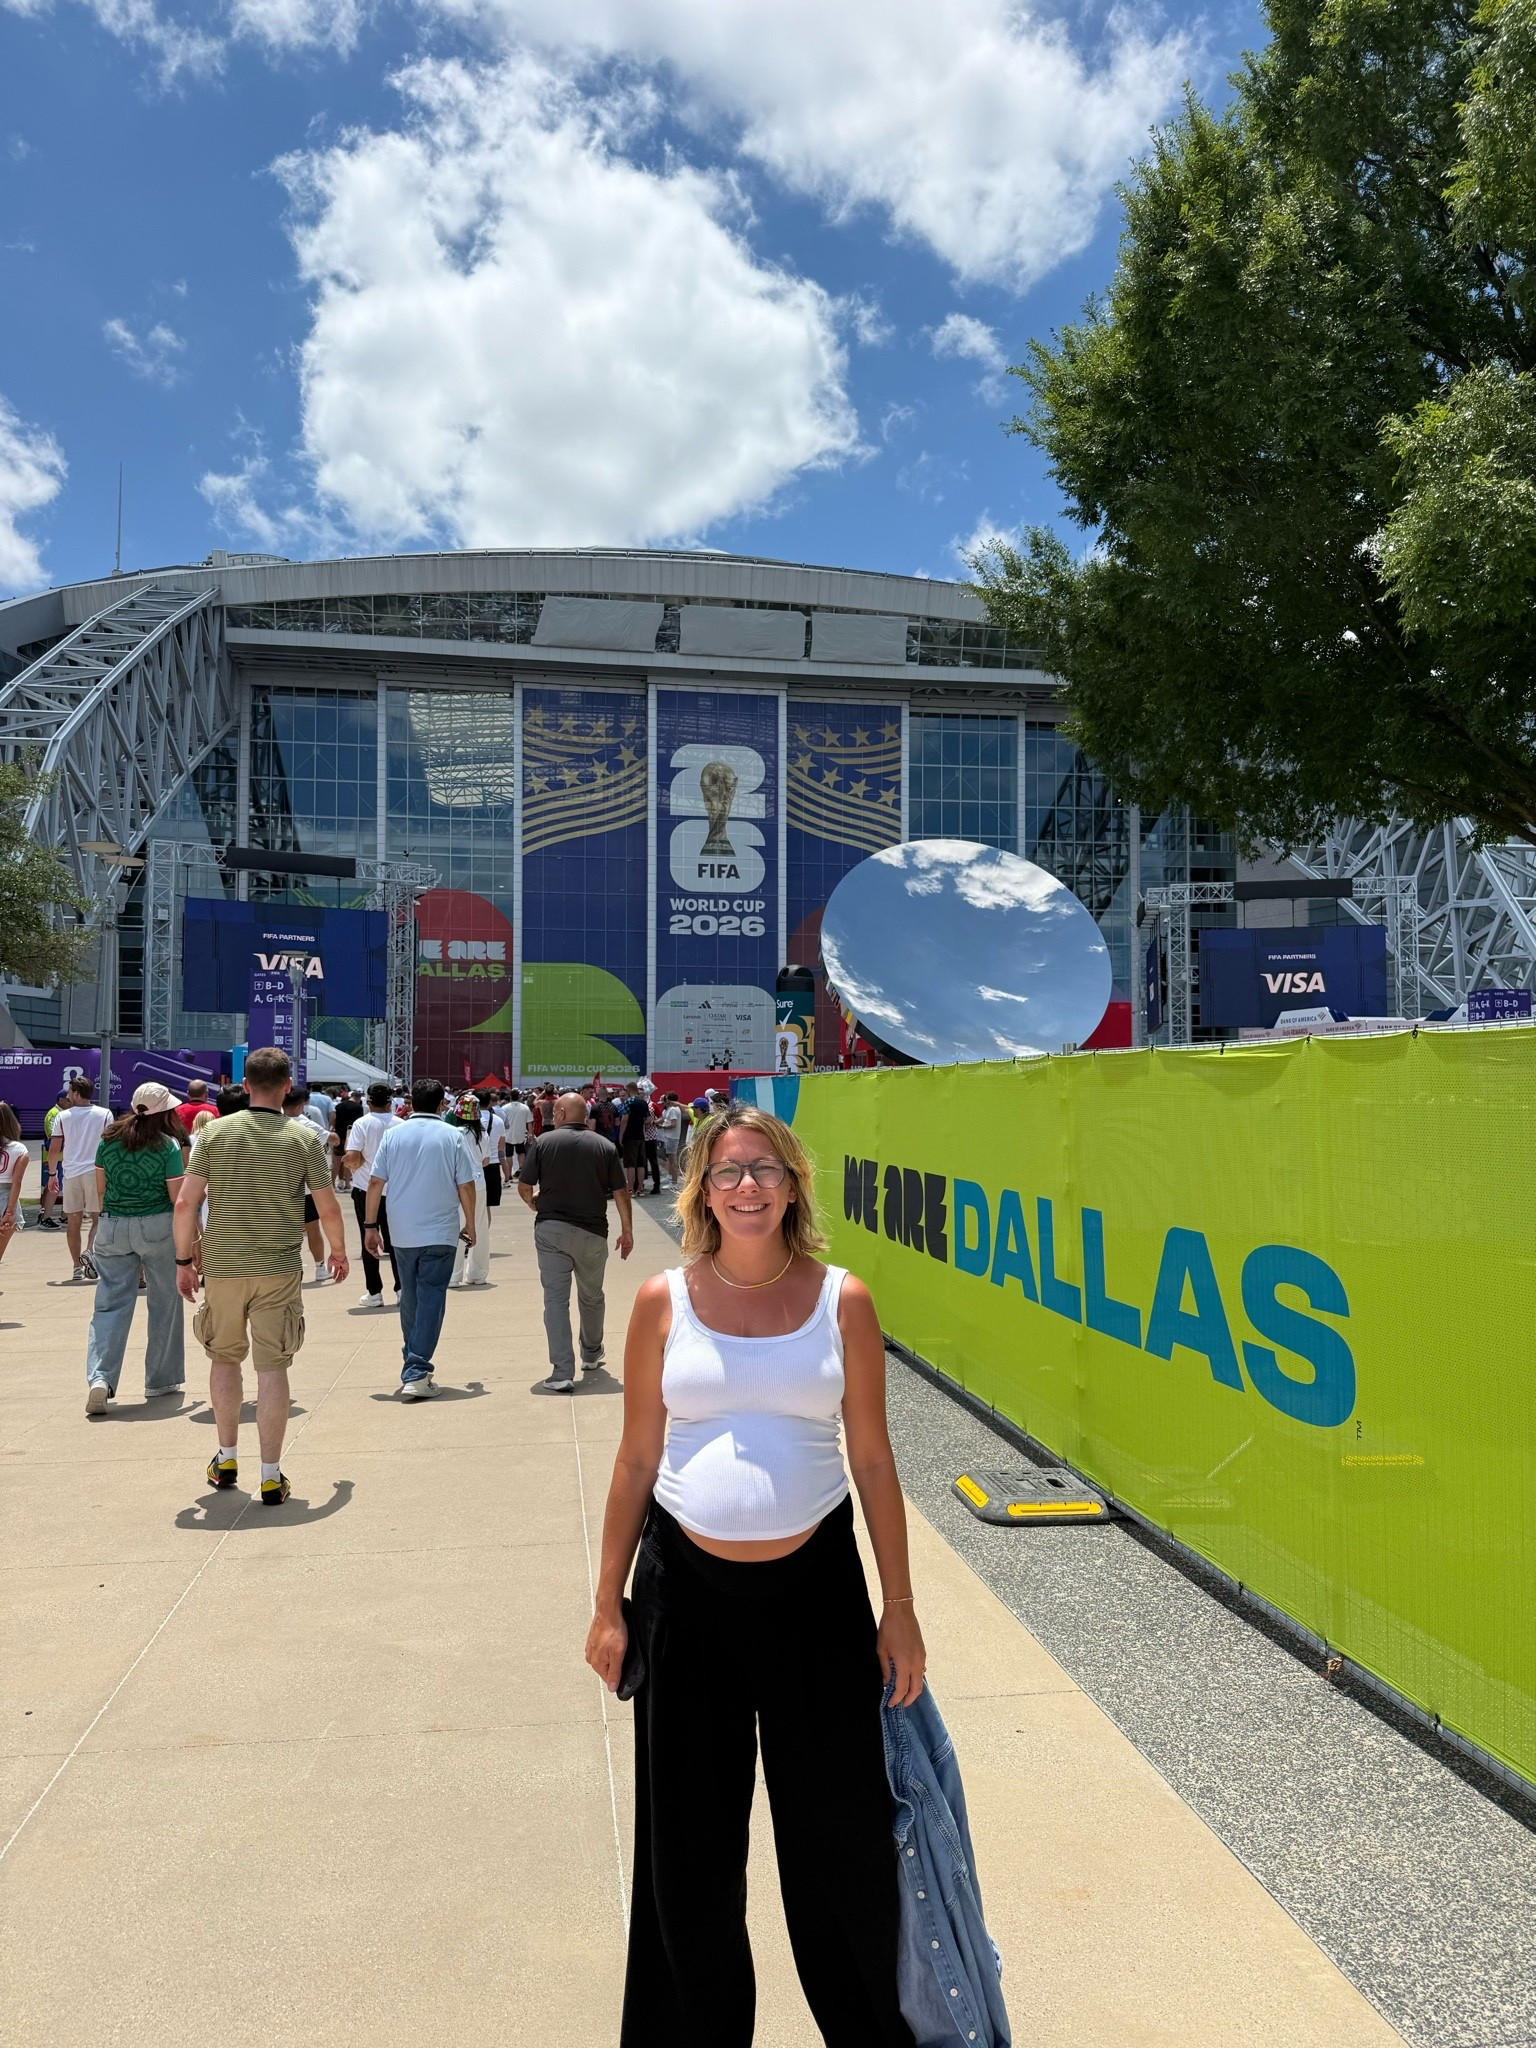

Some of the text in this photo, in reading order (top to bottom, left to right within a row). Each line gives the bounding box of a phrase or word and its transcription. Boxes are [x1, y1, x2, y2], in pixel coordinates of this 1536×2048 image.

[697, 863, 740, 879] FIFA
[670, 898, 765, 912] WORLD CUP
[669, 914, 765, 937] 2026
[279, 934, 315, 942] PARTNERS
[419, 940, 506, 960] E ARE
[419, 963, 506, 977] ALLAS
[1260, 972, 1326, 993] VISA
[776, 1000, 793, 1009] Sure
[527, 1064, 640, 1073] FIFA WORLD CUP 2026
[843, 1154, 1356, 1428] WE ARE DALLAS
[1356, 1420, 1362, 1440] TM
